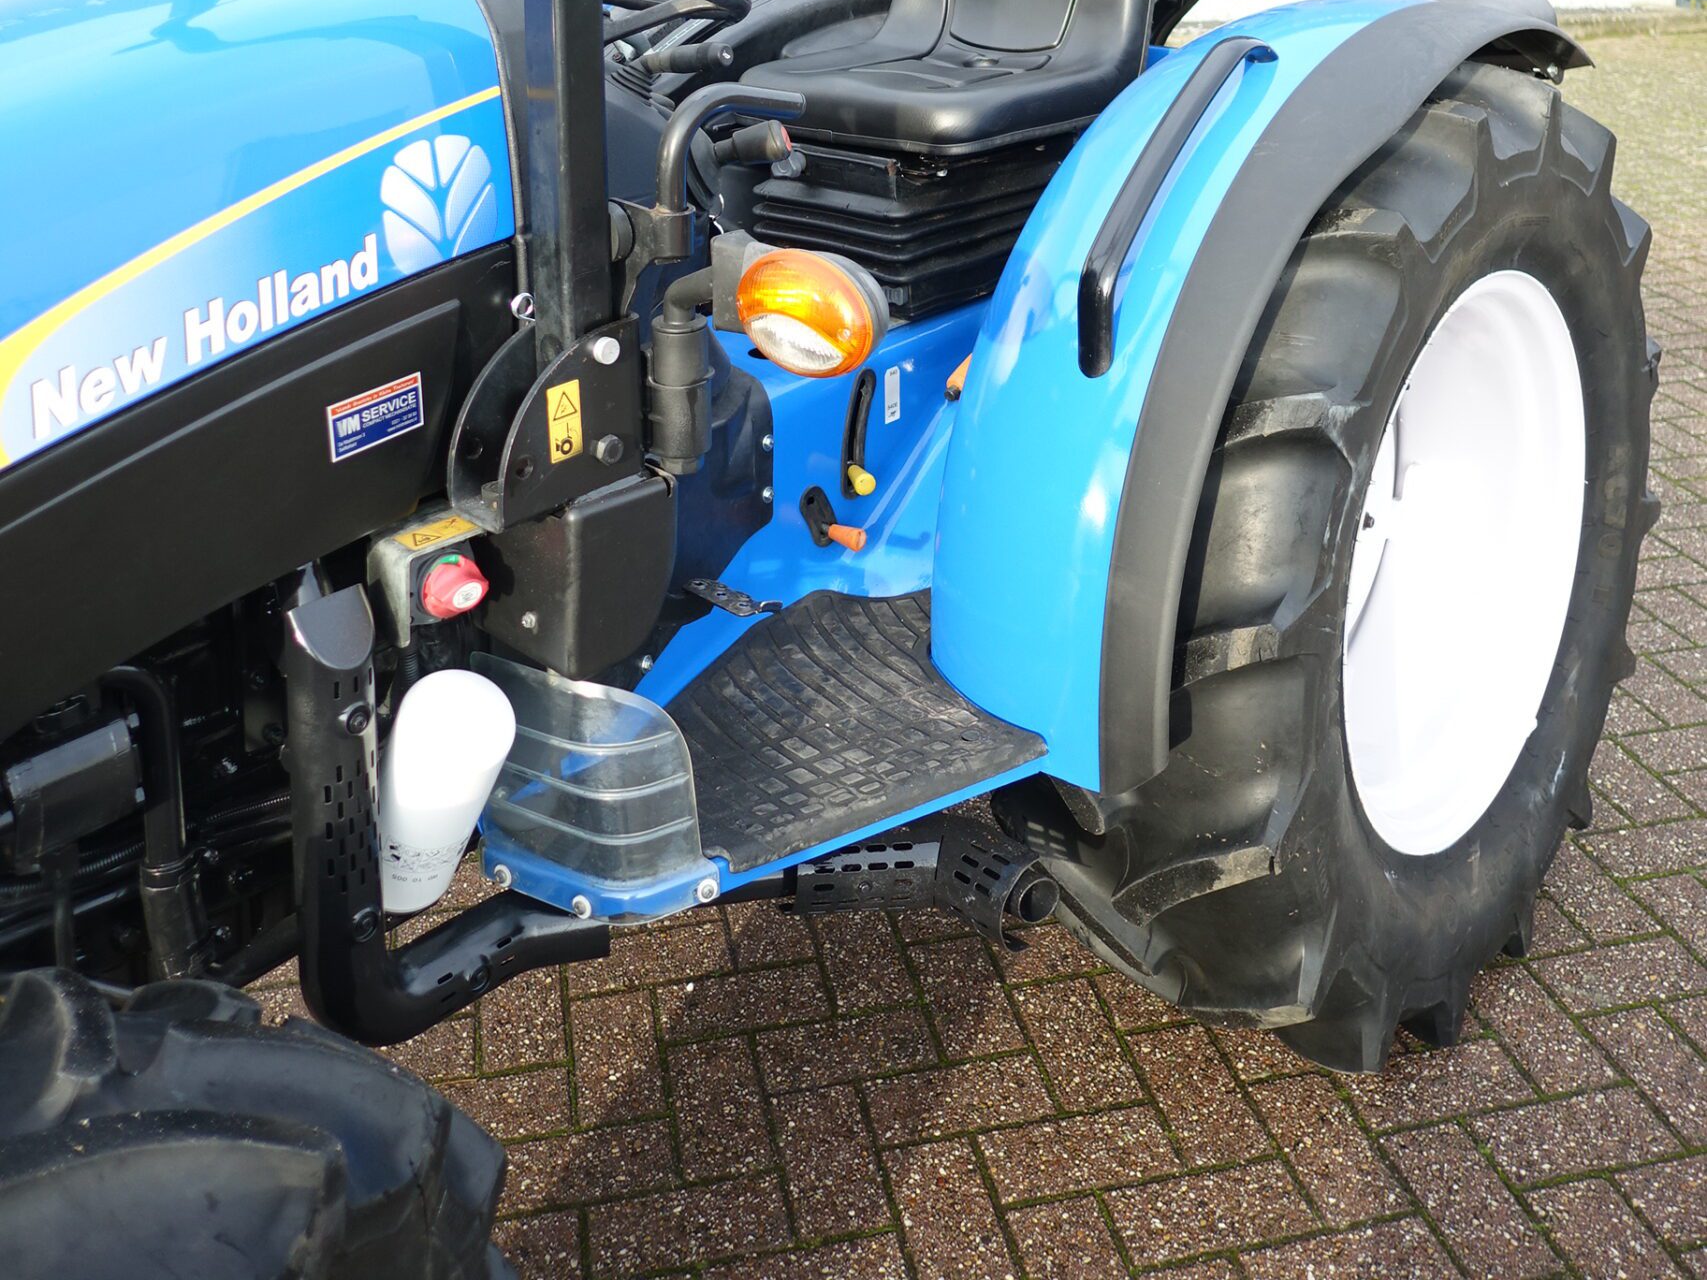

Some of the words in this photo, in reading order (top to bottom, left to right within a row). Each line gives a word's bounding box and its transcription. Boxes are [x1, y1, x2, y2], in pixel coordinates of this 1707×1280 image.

[31, 334, 168, 440] New
[183, 232, 380, 366] Holland
[361, 391, 417, 423] SERVICE
